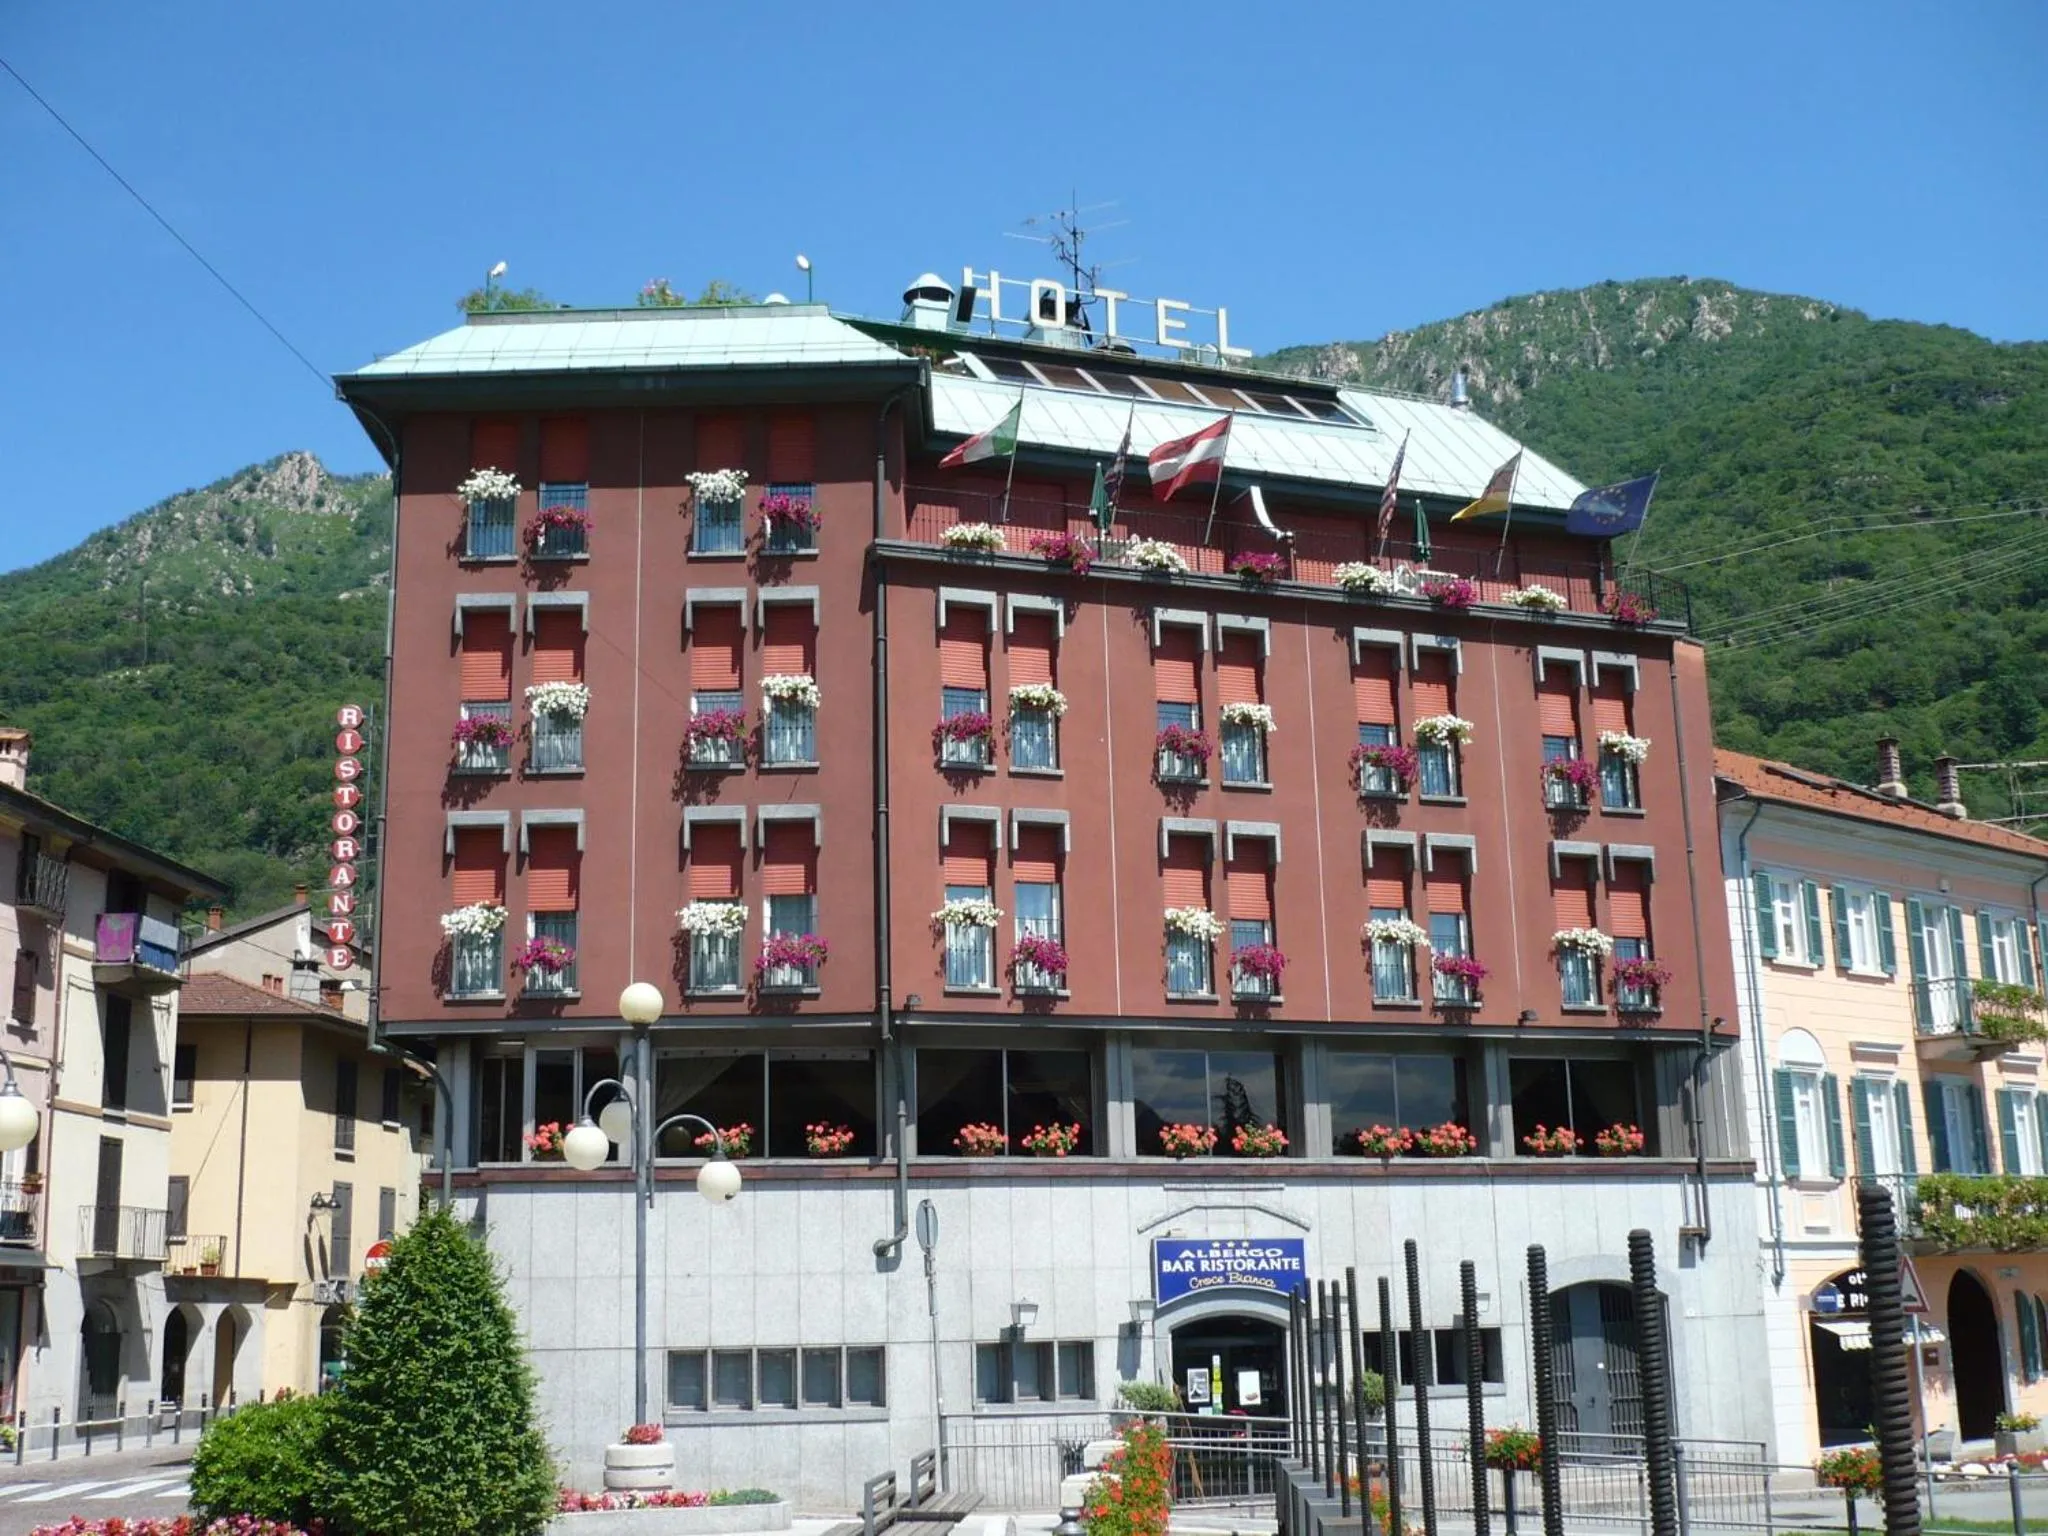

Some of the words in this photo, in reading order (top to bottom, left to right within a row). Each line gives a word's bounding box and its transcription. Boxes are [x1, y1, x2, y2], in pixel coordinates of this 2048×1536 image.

[957, 266, 1252, 359] HOTEL
[330, 711, 361, 968] RISTORANTE
[1162, 1260, 1195, 1272] BAR
[1201, 1257, 1300, 1272] RISTORANTE
[1179, 1248, 1283, 1258] ALBERGO
